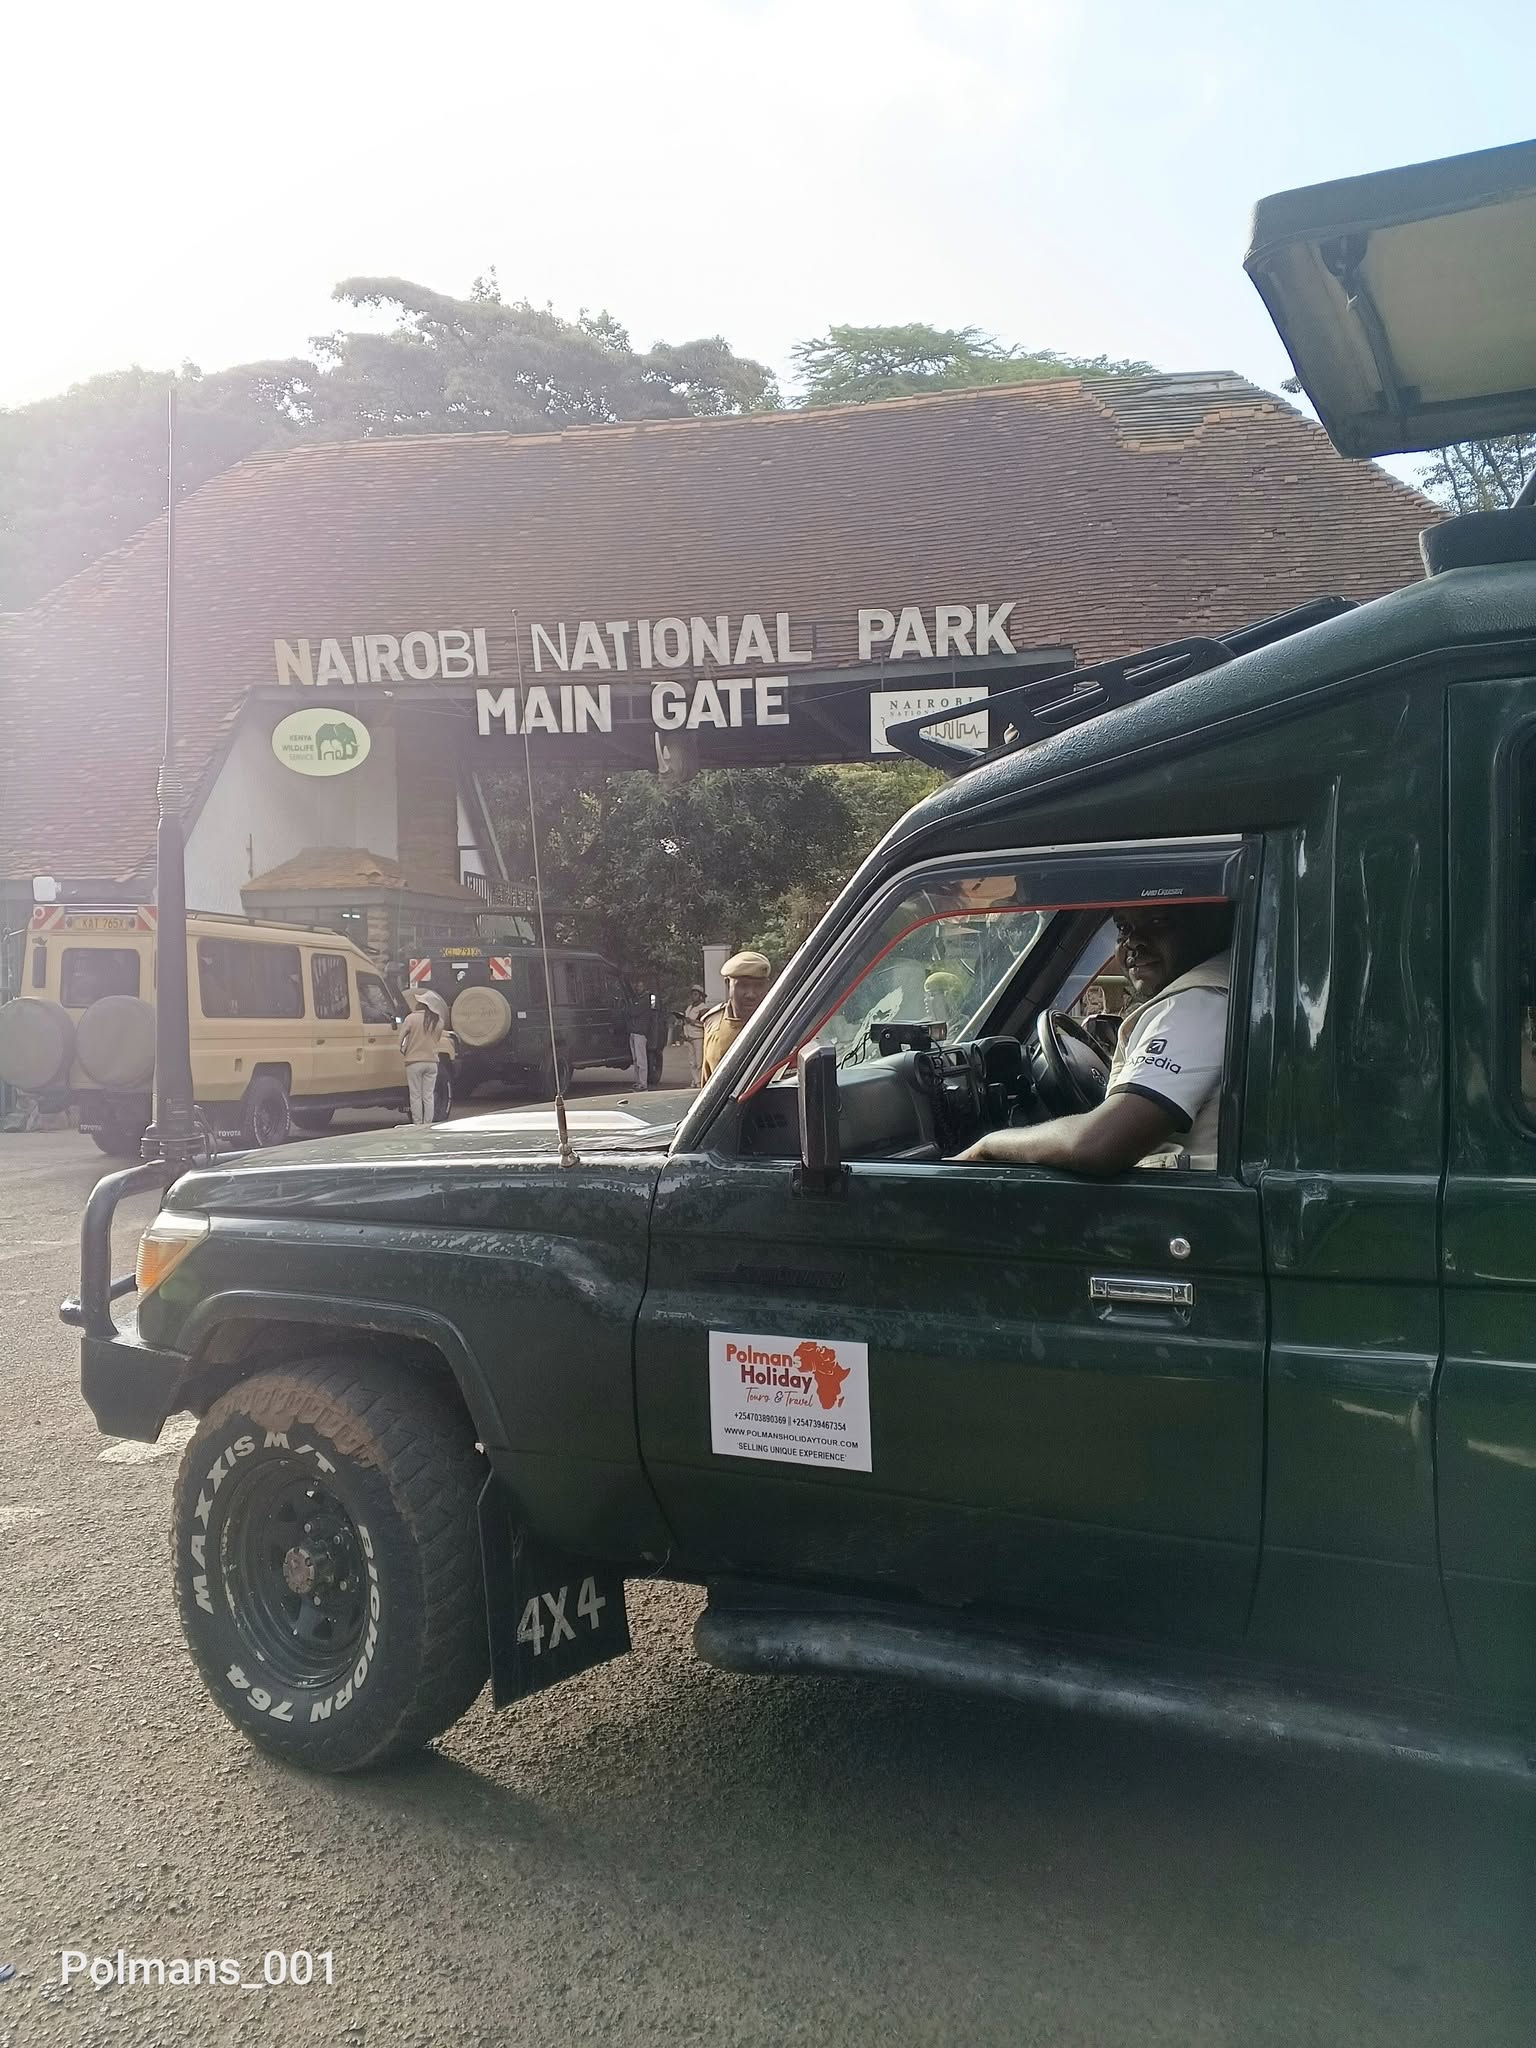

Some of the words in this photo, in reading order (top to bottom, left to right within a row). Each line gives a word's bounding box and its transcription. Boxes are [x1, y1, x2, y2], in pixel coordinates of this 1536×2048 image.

[273, 627, 489, 686] NAIROBI
[530, 612, 812, 672] NATIONAL
[858, 602, 1017, 660] PARK
[476, 684, 612, 736] MAIN
[651, 675, 790, 731] GATE
[282, 744, 315, 752] WILDLIFE
[741, 1364, 813, 1394] Holiday
[746, 1386, 770, 1403] Tours
[774, 1390, 784, 1404] &
[784, 1390, 814, 1407] Travel
[724, 1427, 859, 1449] WWW.POLMANSHOLIDAYTOUR.COM
[769, 1445, 798, 1457] UNIQUE
[191, 1435, 255, 1615] MAXXIS
[309, 1525, 380, 1723] BIGHORN
[516, 1576, 606, 1657] 4X4
[226, 1664, 294, 1722] 764
